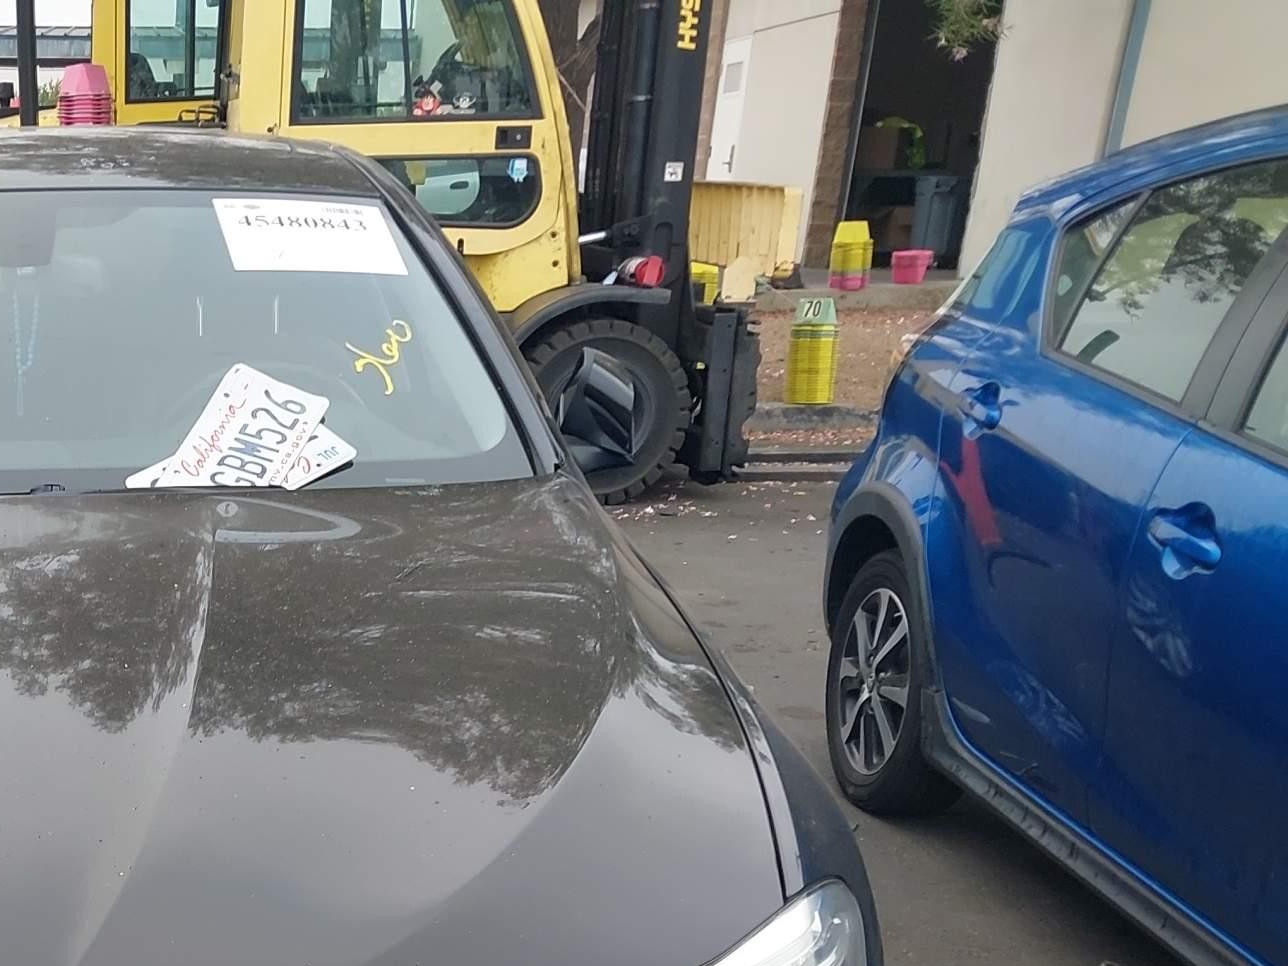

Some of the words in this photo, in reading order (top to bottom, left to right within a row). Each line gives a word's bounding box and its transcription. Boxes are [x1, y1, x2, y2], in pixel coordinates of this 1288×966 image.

[238, 214, 368, 232] 45480843
[803, 300, 822, 317] 70
[181, 399, 247, 477] California
[316, 446, 339, 461] JUL
